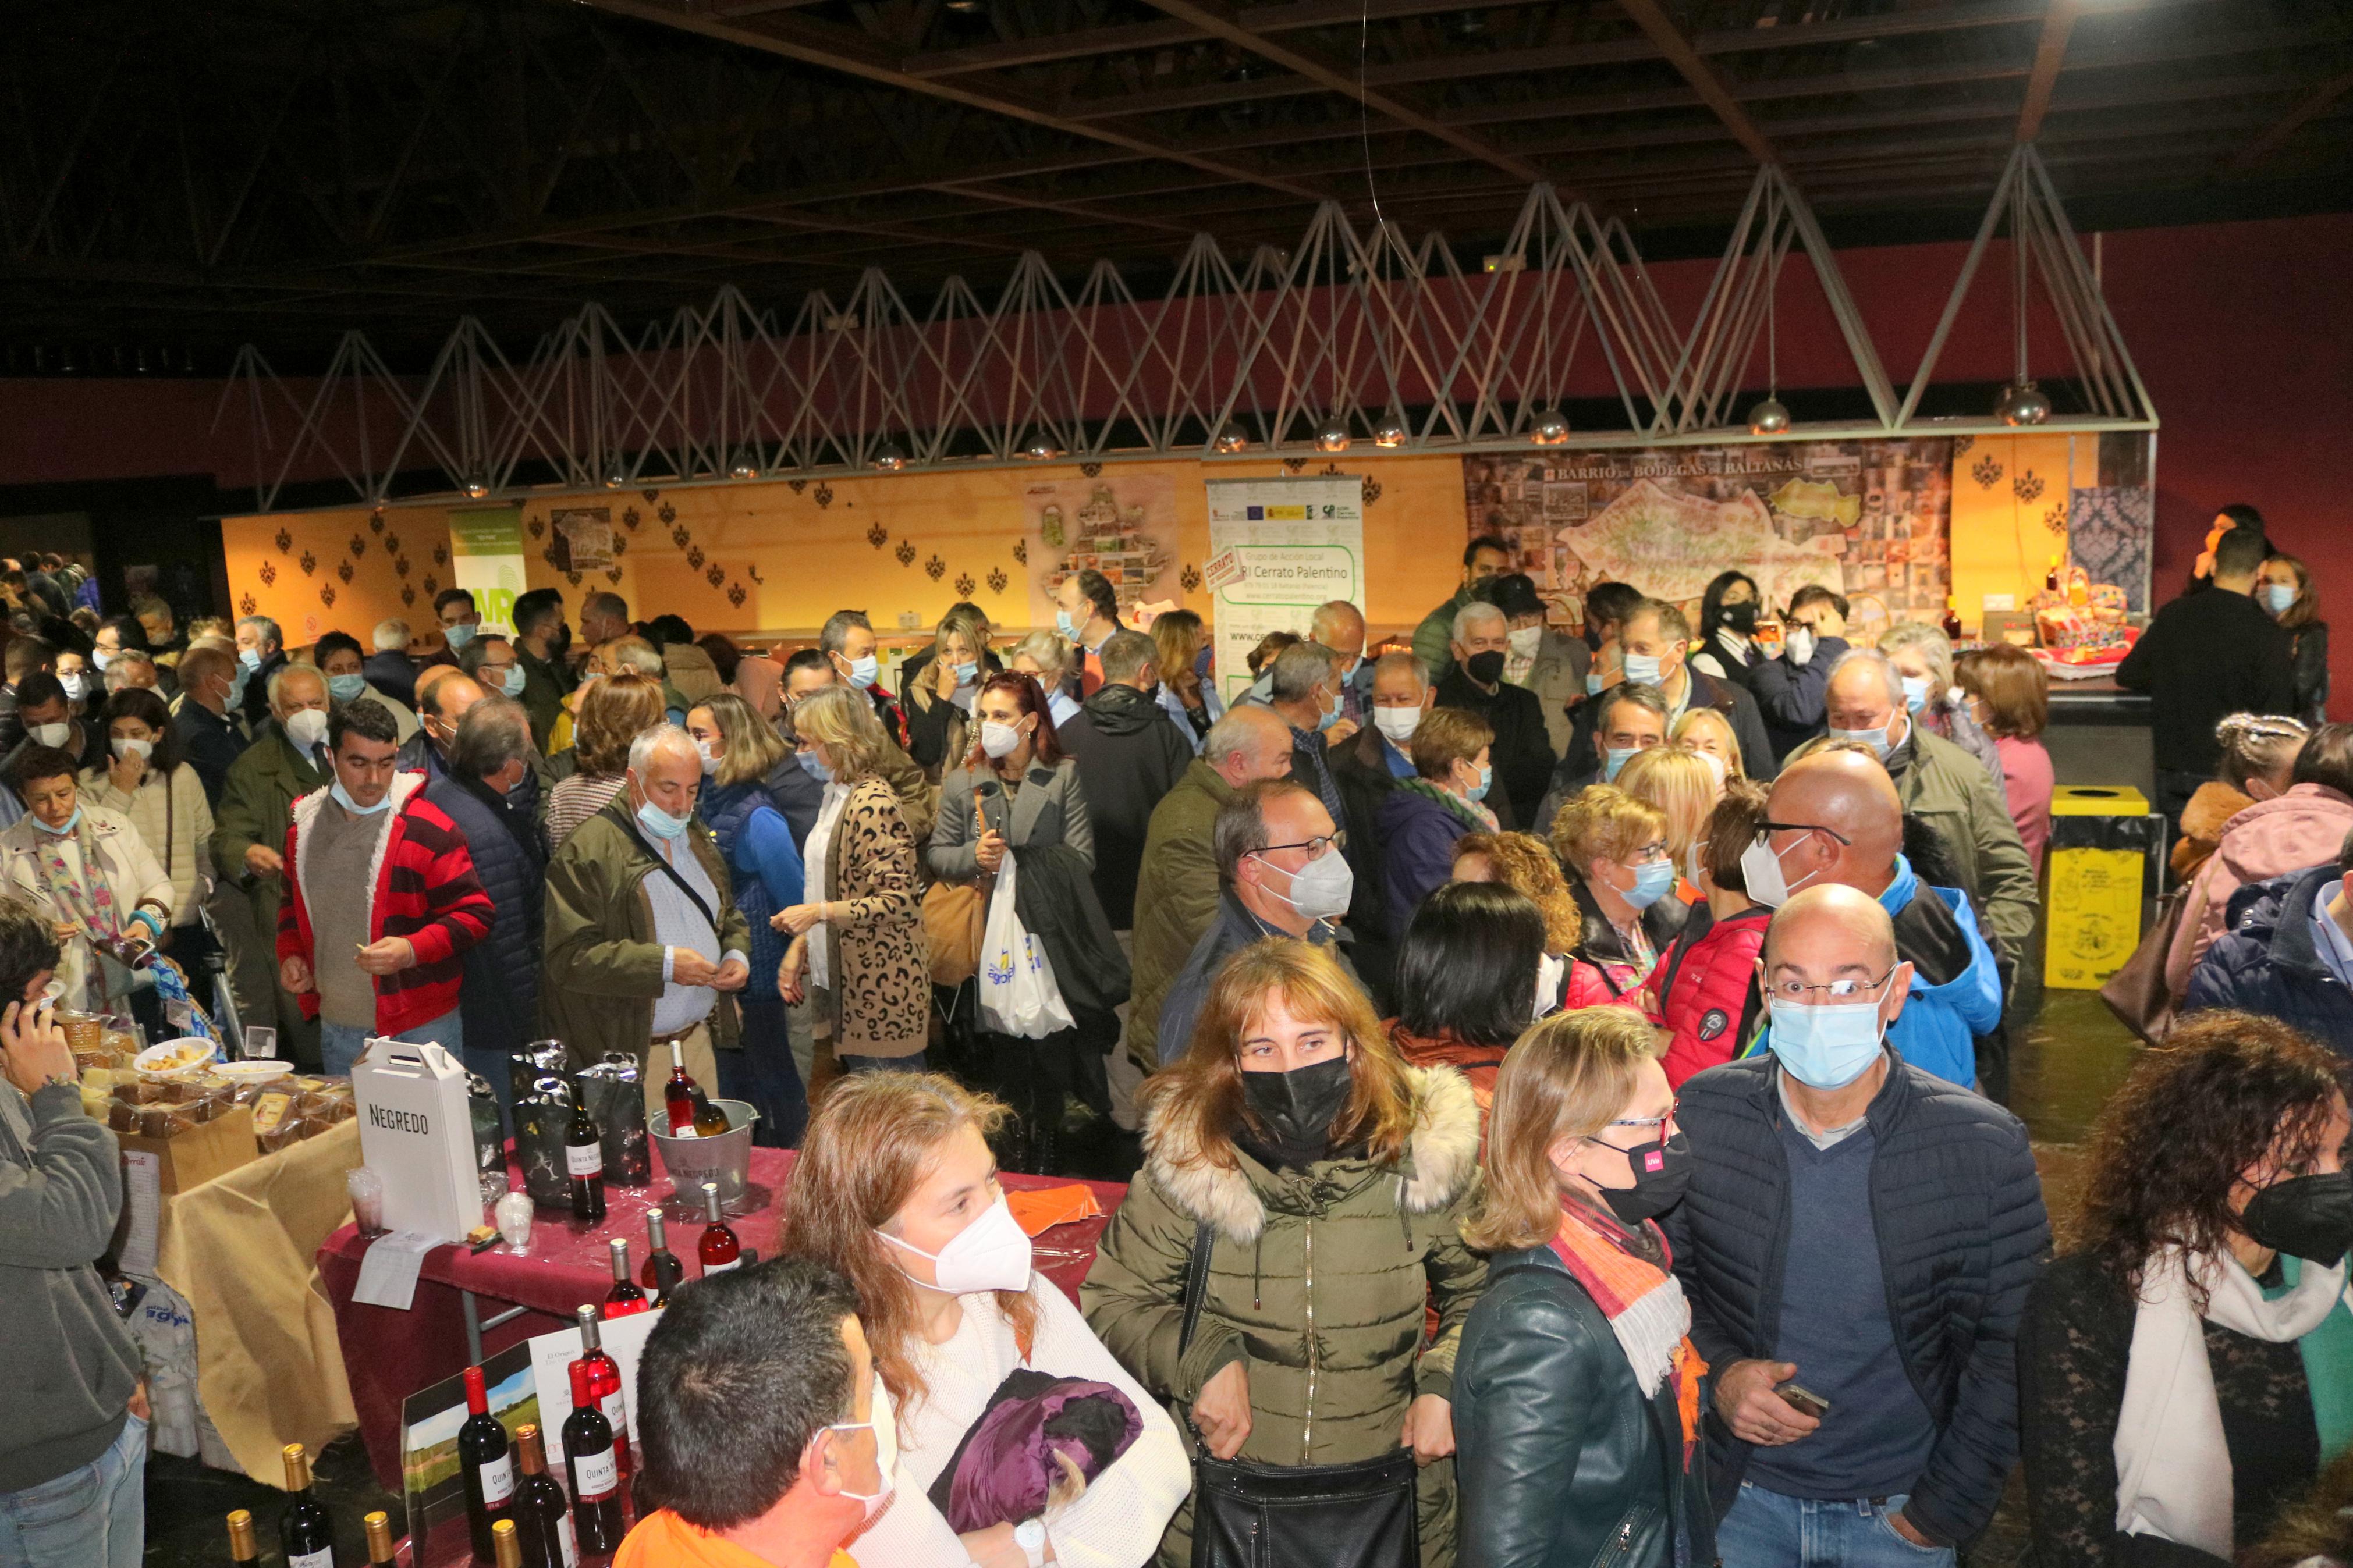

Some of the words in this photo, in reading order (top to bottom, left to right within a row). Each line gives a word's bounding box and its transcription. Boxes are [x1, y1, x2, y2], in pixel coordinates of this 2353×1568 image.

[1557, 467, 1617, 480] BARRIO
[1633, 465, 1706, 478] BODEGAS
[1724, 458, 1802, 474] BALTANÁS
[1245, 552, 1267, 561] Grupo
[1269, 553, 1278, 561] de
[1280, 552, 1304, 561] Acción
[1305, 553, 1324, 561] Local
[1254, 566, 1294, 578] Cerrato
[1297, 566, 1348, 579] Palentino
[369, 1103, 428, 1135] NEGREDO
[586, 1466, 609, 1480] QUINTA
